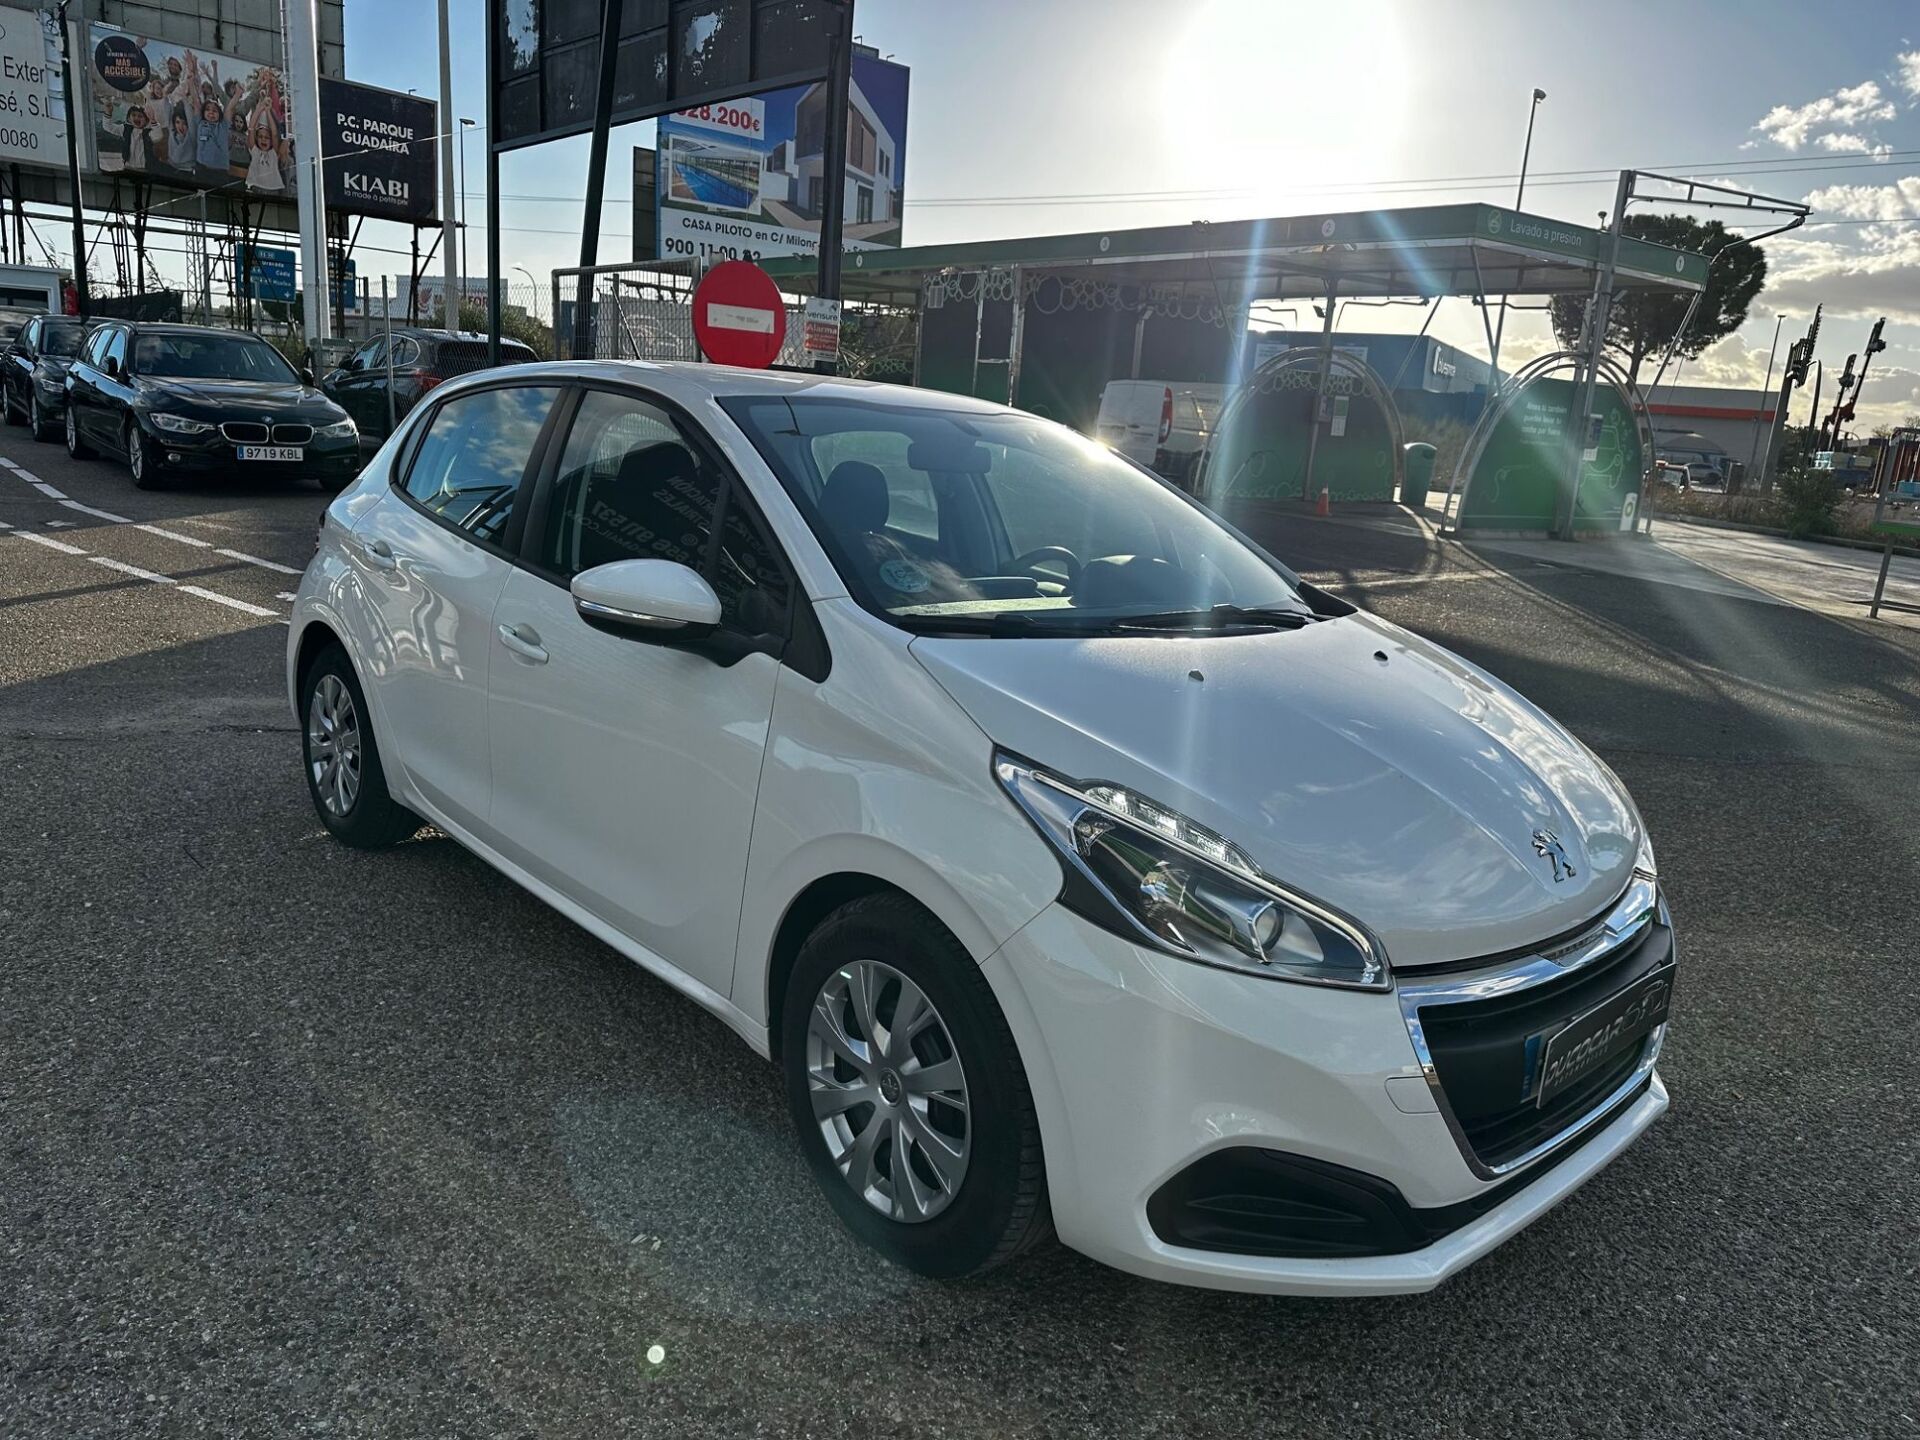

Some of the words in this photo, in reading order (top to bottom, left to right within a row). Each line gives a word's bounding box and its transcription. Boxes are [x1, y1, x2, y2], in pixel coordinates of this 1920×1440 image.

[337, 112, 360, 129] P.C.
[363, 118, 414, 140] PARQUE
[341, 130, 410, 155] GUADAÍRA
[343, 172, 410, 199] KIABI
[352, 191, 371, 200] mode
[682, 217, 712, 232] CASA
[715, 222, 752, 238] PILOTO
[755, 231, 768, 241] en
[770, 232, 784, 244] C/
[1510, 218, 1542, 238] Lavado
[1543, 229, 1549, 240] a
[1551, 230, 1582, 247] presión
[665, 237, 695, 256] 900
[246, 448, 278, 459] 9719
[279, 449, 302, 460] KBL
